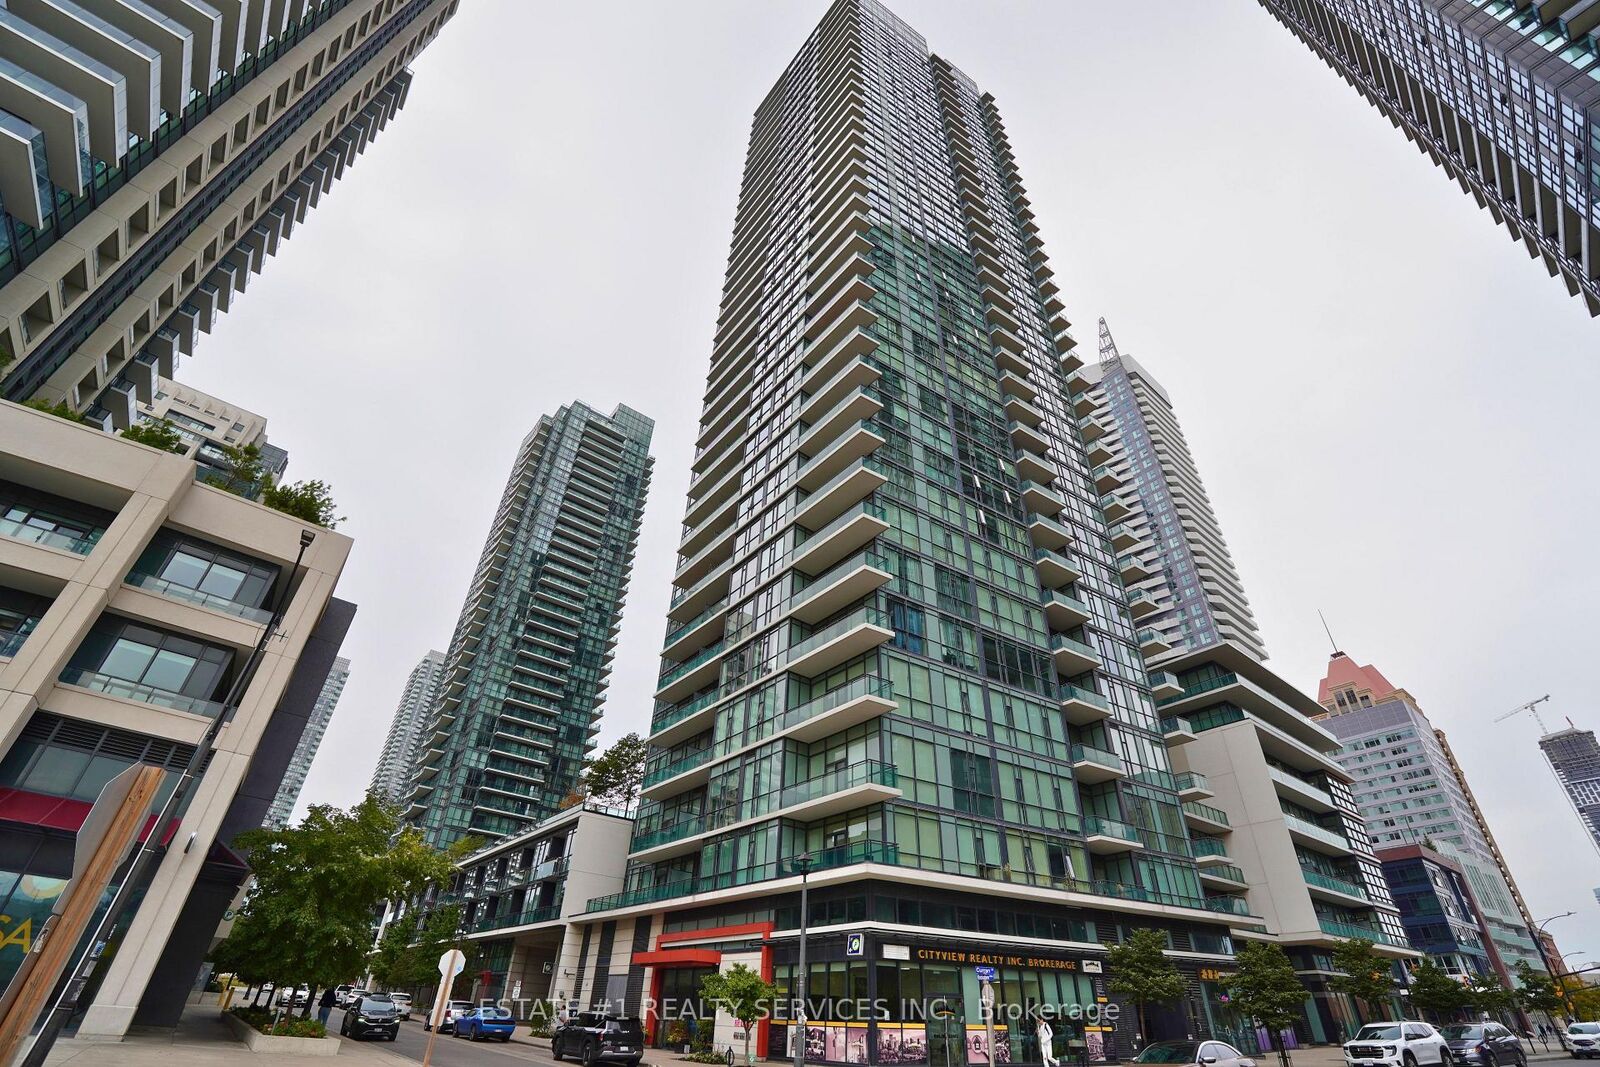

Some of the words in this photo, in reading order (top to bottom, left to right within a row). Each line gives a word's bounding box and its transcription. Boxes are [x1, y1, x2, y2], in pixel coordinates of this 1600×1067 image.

[918, 949, 965, 962] CITYVIEW
[969, 954, 1004, 965] REALTY
[1007, 957, 1026, 967] INC.
[1028, 958, 1077, 970] BROKERAGE
